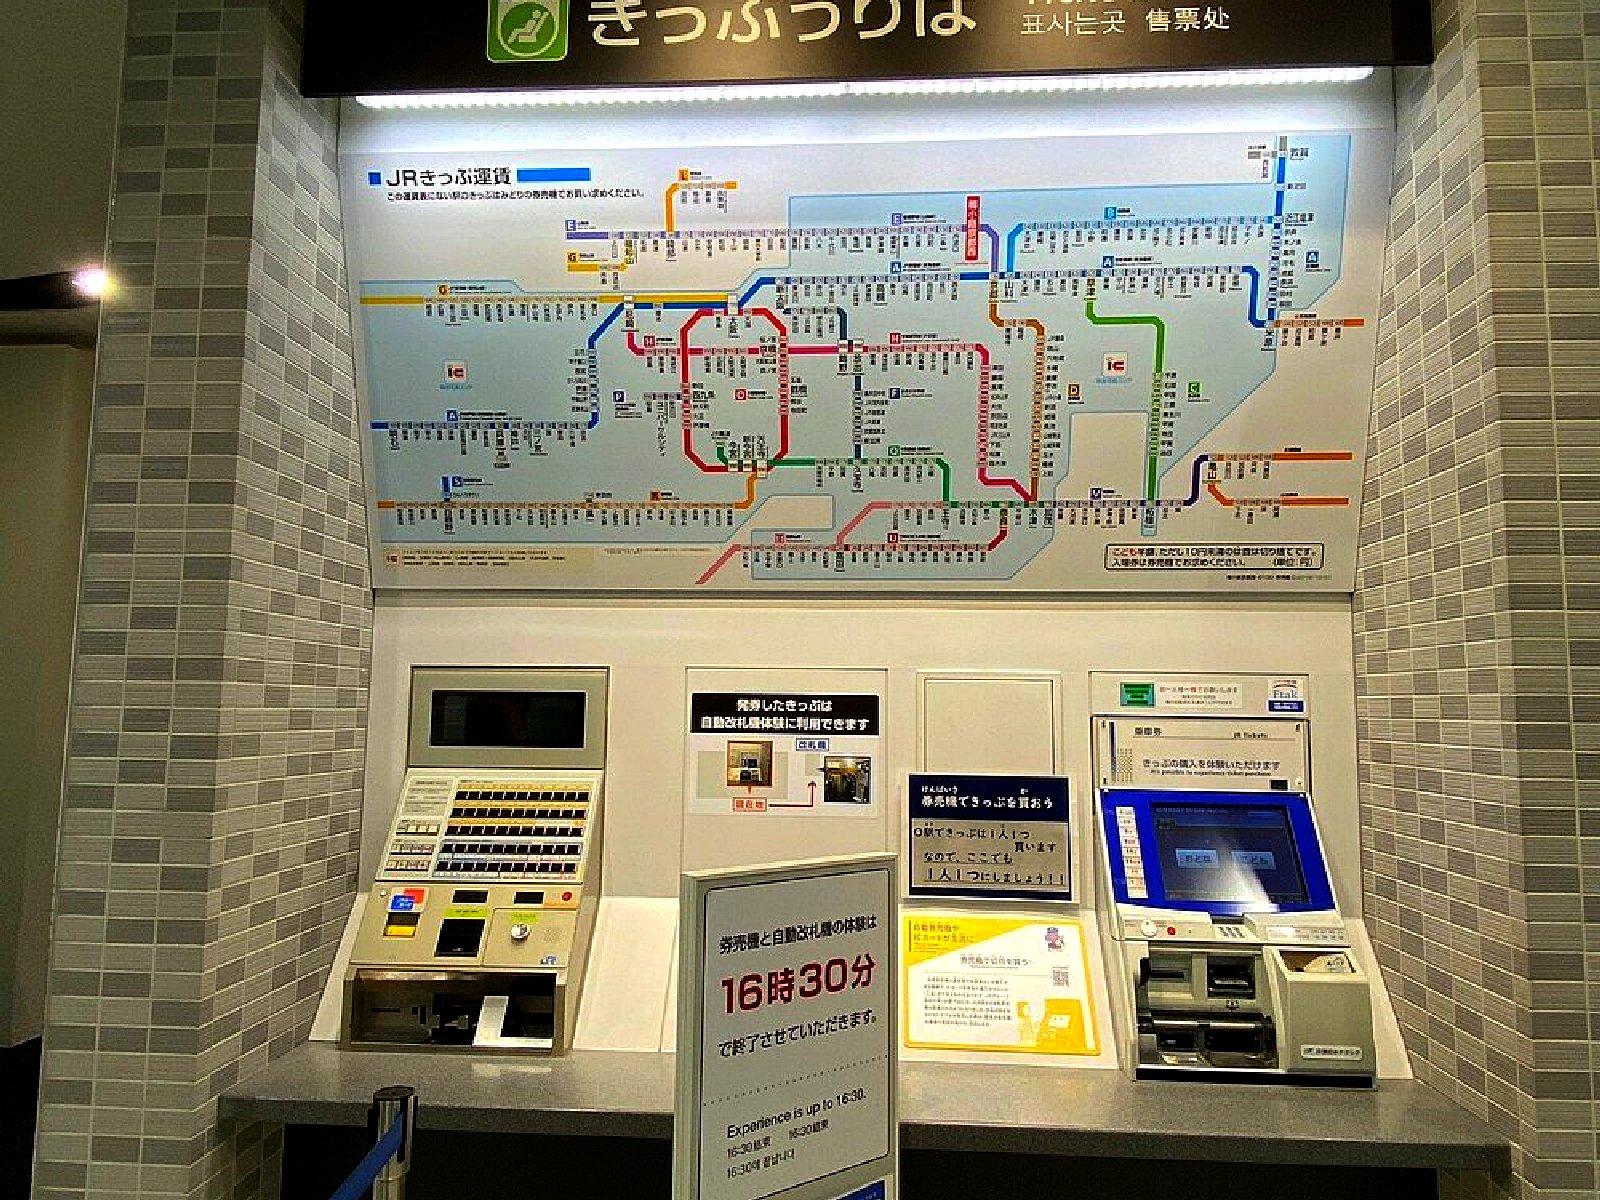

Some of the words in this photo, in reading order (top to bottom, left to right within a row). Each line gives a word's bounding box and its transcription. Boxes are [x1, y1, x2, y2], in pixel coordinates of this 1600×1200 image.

[1146, 7, 1231, 33] 售票处
[386, 167, 511, 187] JRきっぷ運賃
[737, 698, 833, 712] 発券したきっぷは
[921, 795, 1053, 809] 券売機できっぷを買おう
[719, 914, 878, 955] 券売機と自動改札機の体験は
[721, 953, 877, 1014] 16時30分
[718, 1008, 878, 1057] で終了させていただきます。
[727, 1111, 791, 1138] Experience
[793, 1106, 803, 1119] is
[806, 1103, 821, 1116] up
[823, 1099, 834, 1111] to
